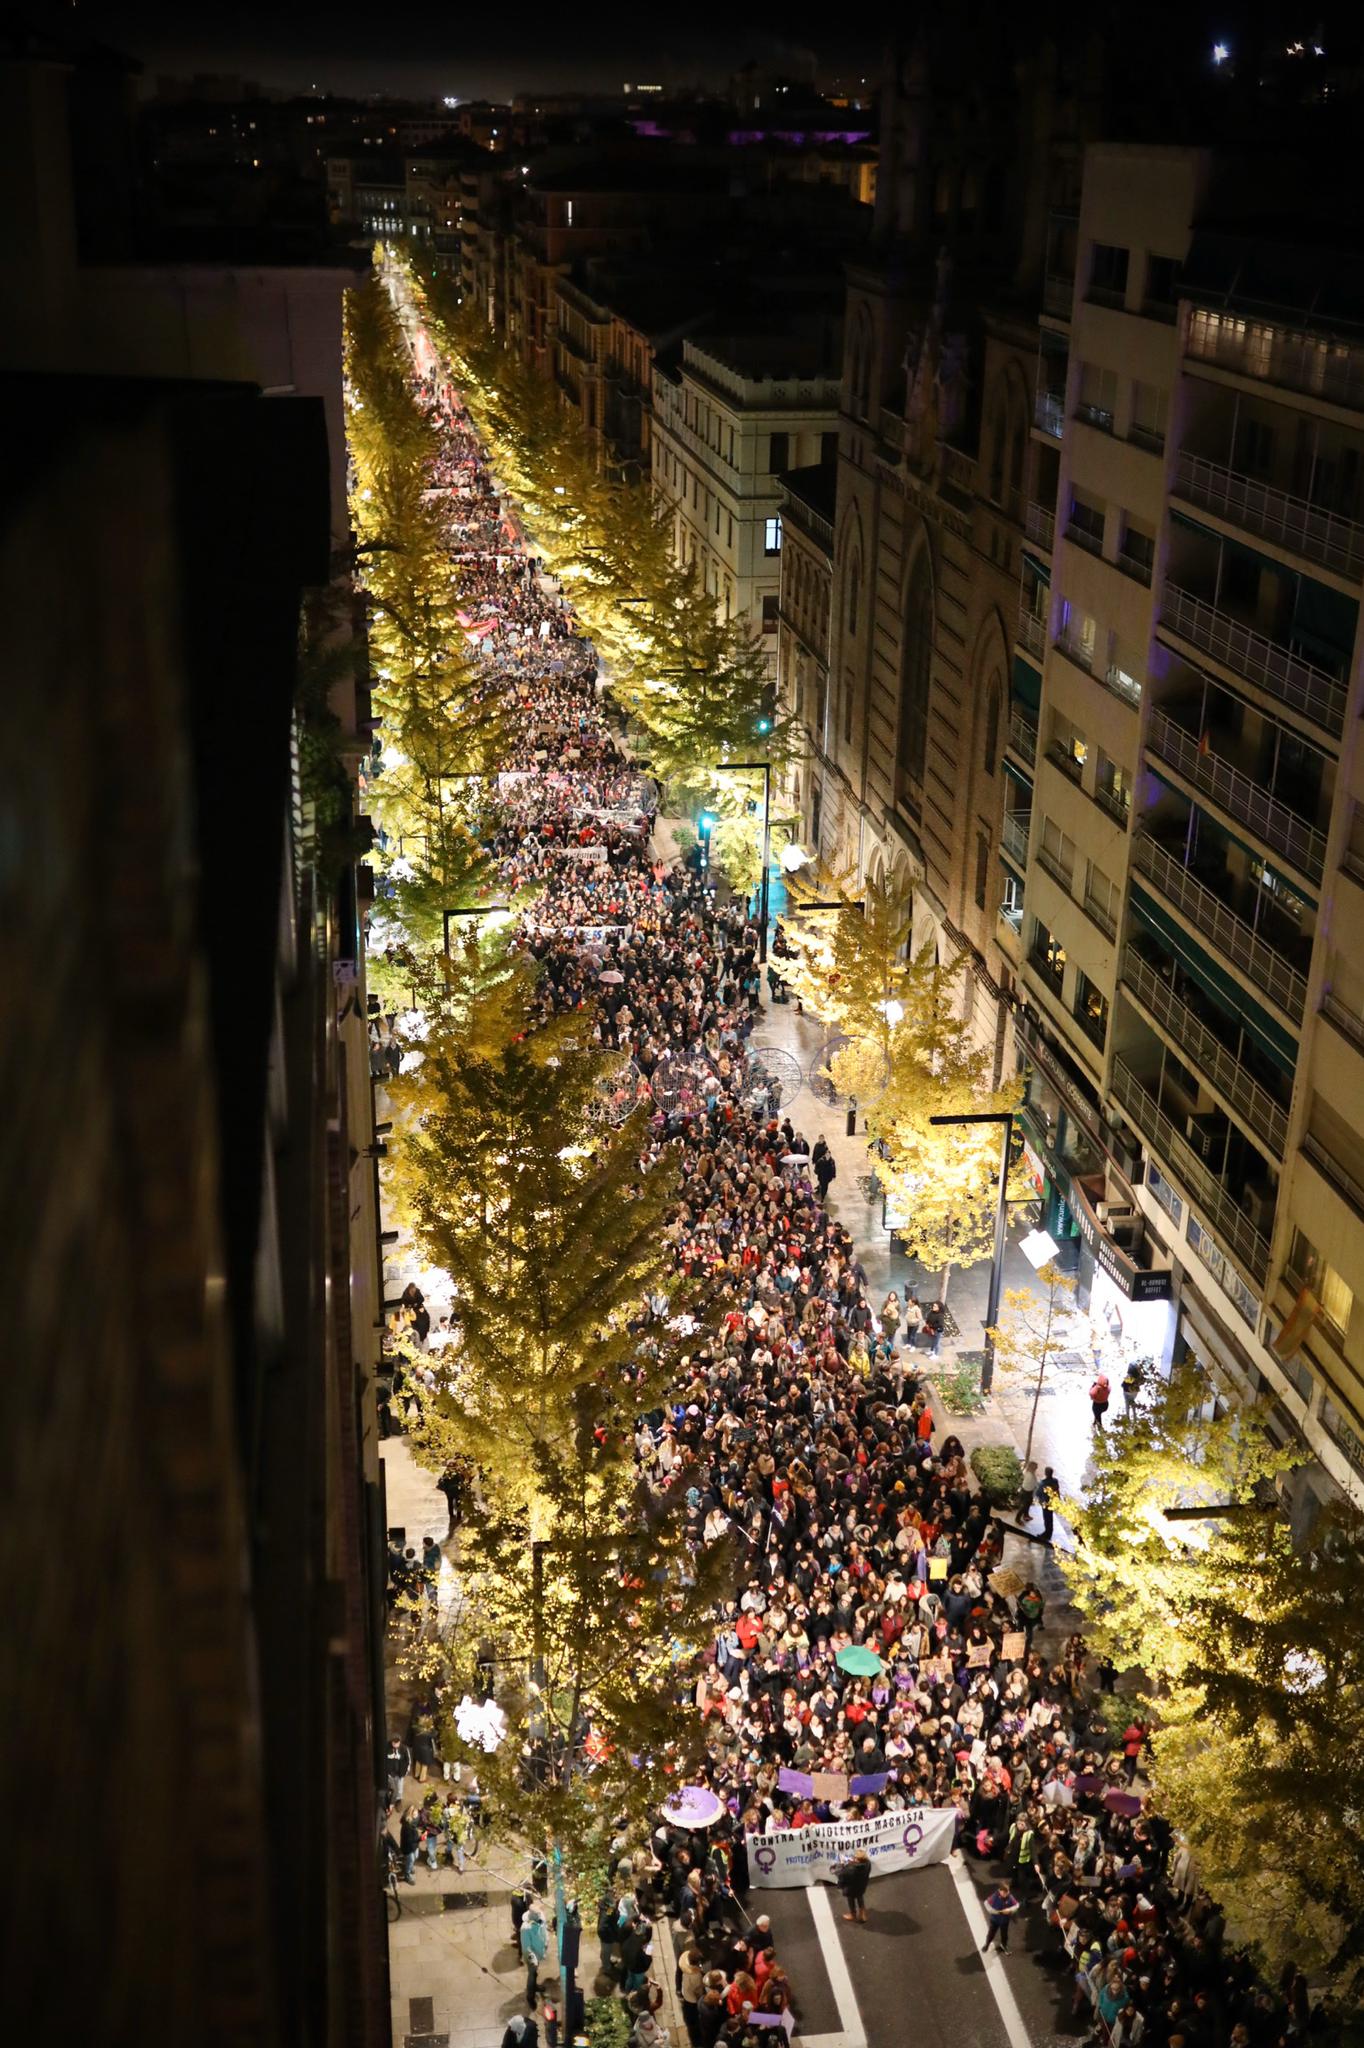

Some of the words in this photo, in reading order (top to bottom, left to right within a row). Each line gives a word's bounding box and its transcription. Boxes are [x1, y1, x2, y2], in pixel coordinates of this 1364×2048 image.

[753, 1834, 794, 1846] CONTRA
[800, 1831, 810, 1841] LA
[815, 1823, 871, 1837] VIOLENCIA
[875, 1811, 924, 1830] MACHISTA
[802, 1835, 879, 1852] INSTITUCIONAL
